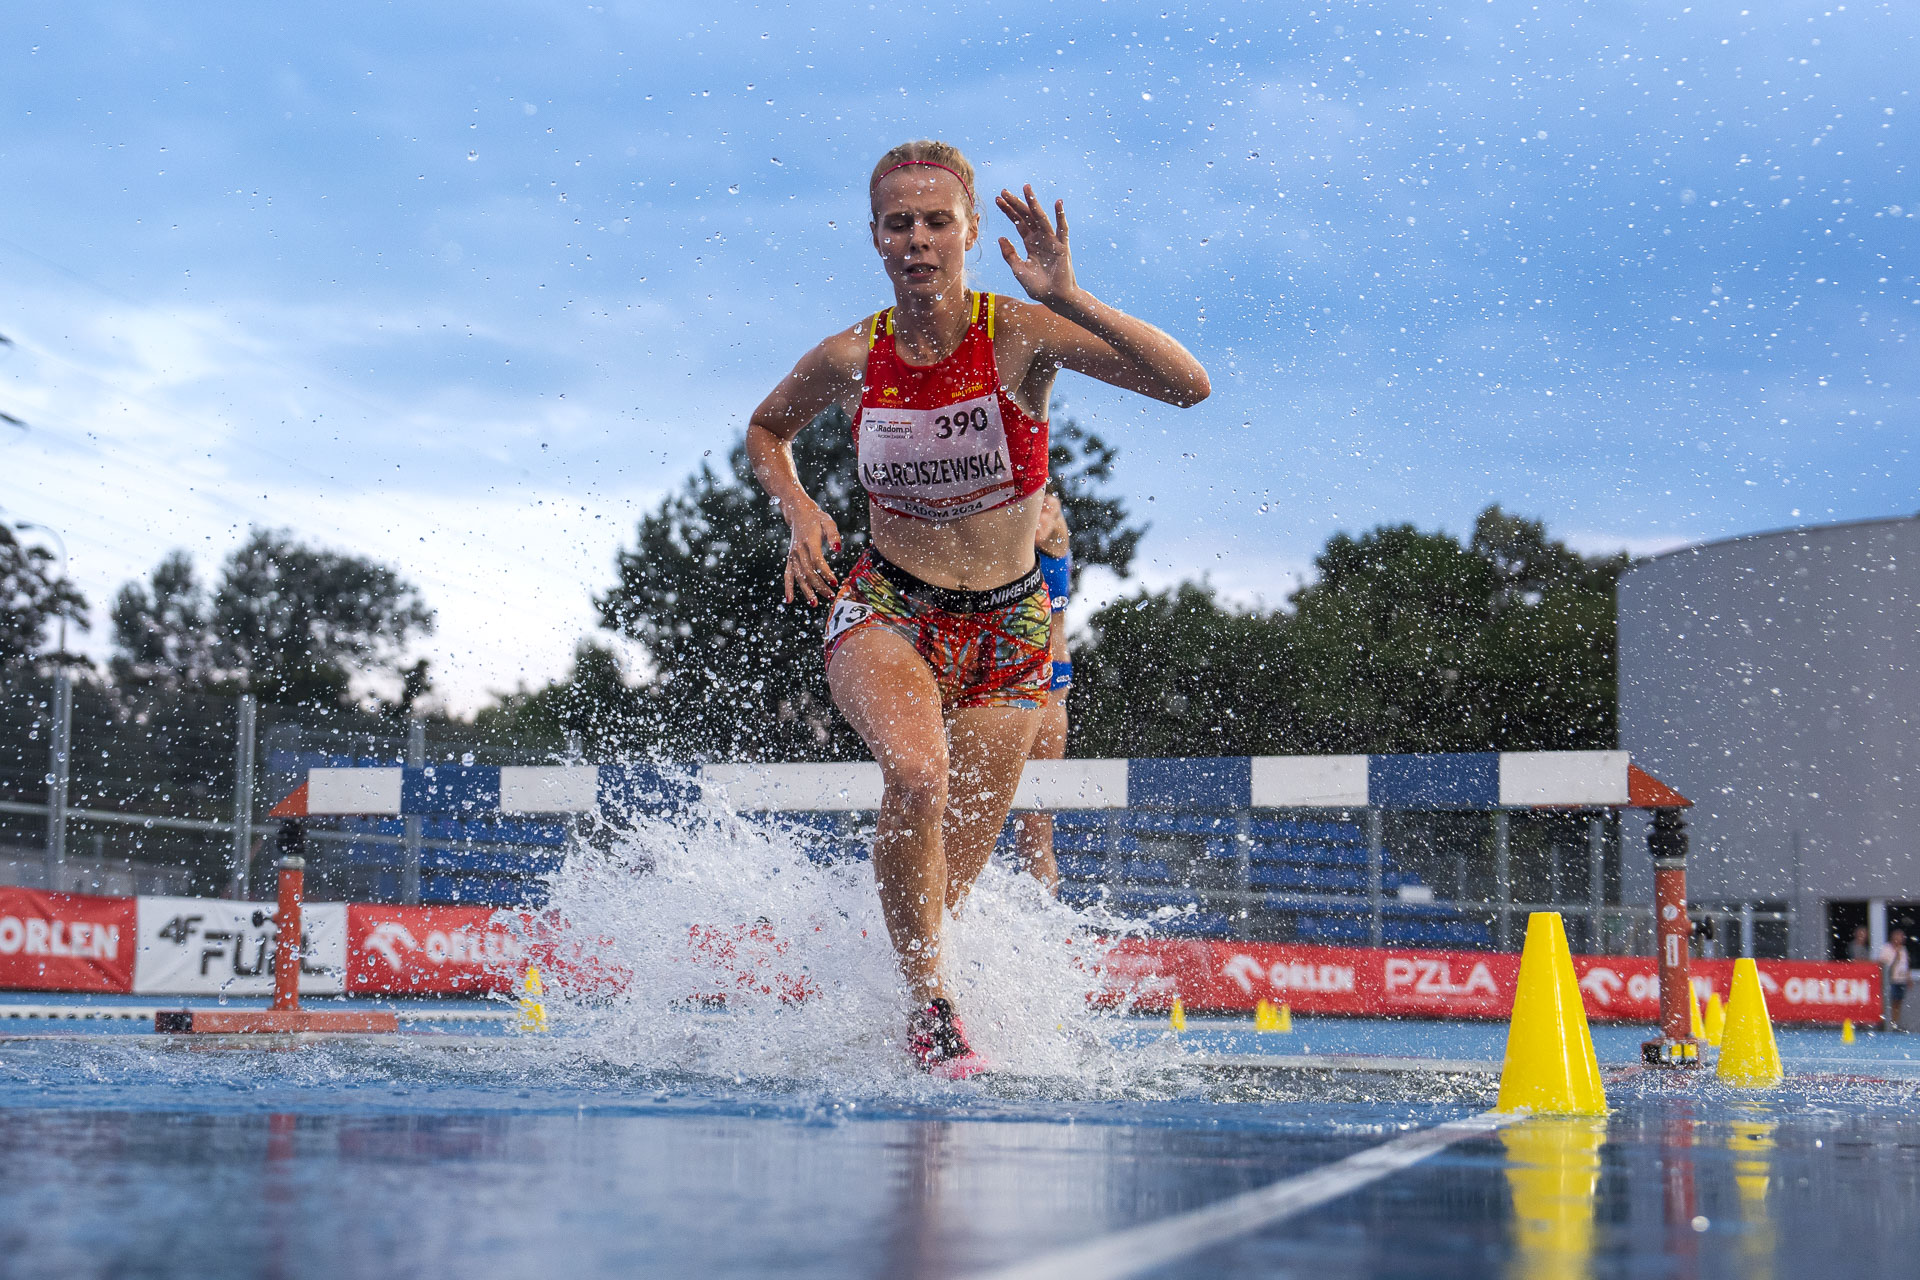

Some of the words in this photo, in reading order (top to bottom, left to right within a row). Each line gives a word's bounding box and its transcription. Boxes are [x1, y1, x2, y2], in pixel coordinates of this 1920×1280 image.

[935, 406, 988, 439] 390
[863, 450, 1007, 486] MARCISZEWSKA
[904, 502, 949, 518] RADOM
[952, 501, 984, 516] 2024
[990, 583, 1023, 605] NIKE
[1024, 568, 1041, 592] PRO
[0, 915, 119, 960] ORLEN
[158, 916, 203, 946] 4F
[200, 931, 329, 976] FUL
[1269, 961, 1355, 992] ORLEN
[1384, 957, 1498, 995] PZLA
[1784, 976, 1871, 1005] ORLEN
